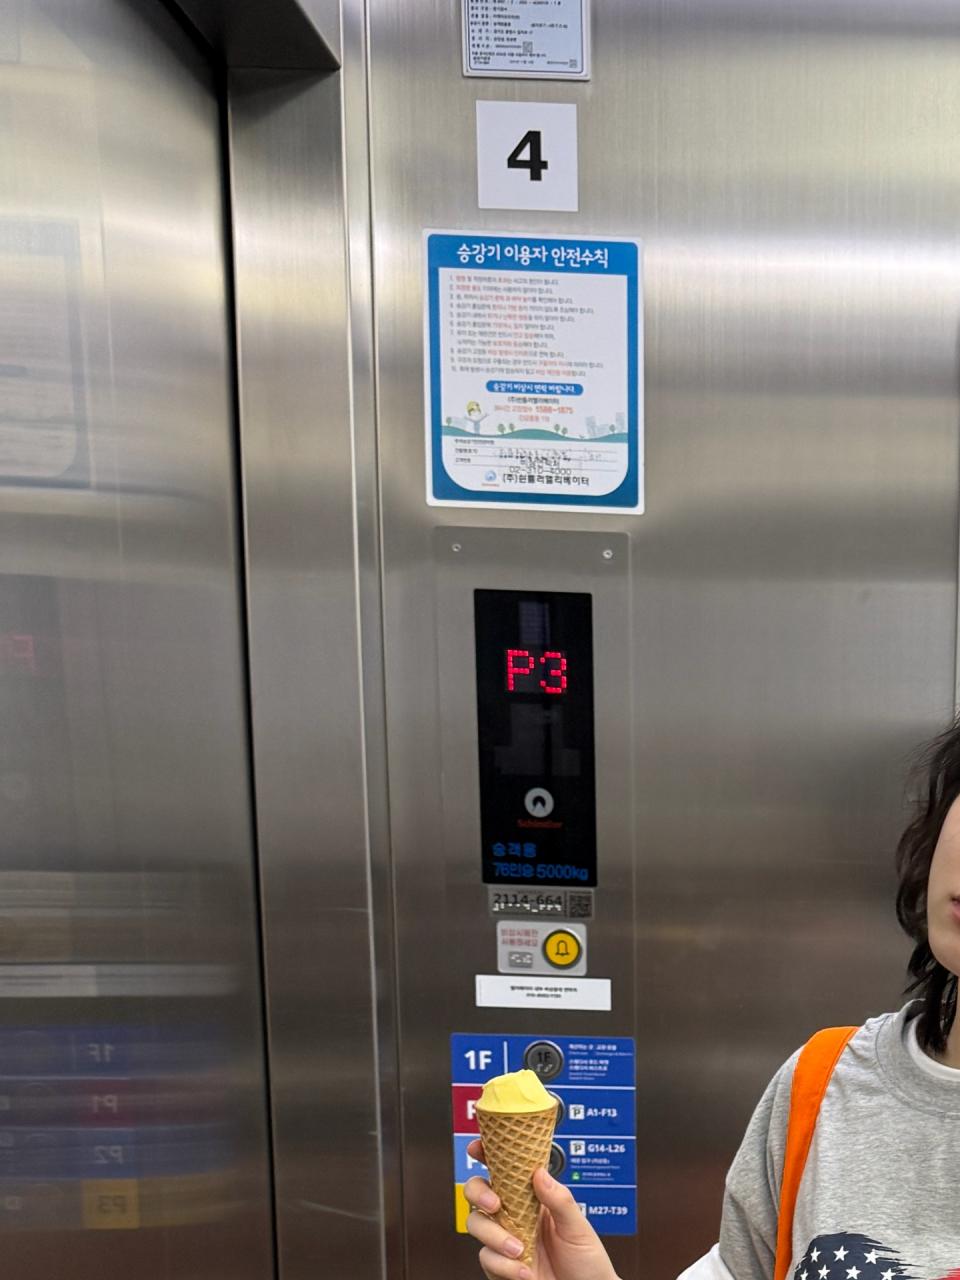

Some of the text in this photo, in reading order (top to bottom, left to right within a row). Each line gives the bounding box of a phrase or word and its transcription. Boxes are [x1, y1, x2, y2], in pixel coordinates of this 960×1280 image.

[507, 130, 548, 181] 4
[457, 243, 609, 269] 승강기 이용자 안전수칙
[507, 649, 567, 694] P3
[536, 863, 589, 881] 5000kg
[493, 893, 563, 905] 2114-664
[464, 1050, 492, 1070] 1F
[537, 1051, 552, 1063] 1F
[586, 1108, 618, 1118] A1-F13
[587, 1143, 626, 1153] G14-L26
[588, 1206, 629, 1216] M27-T39
